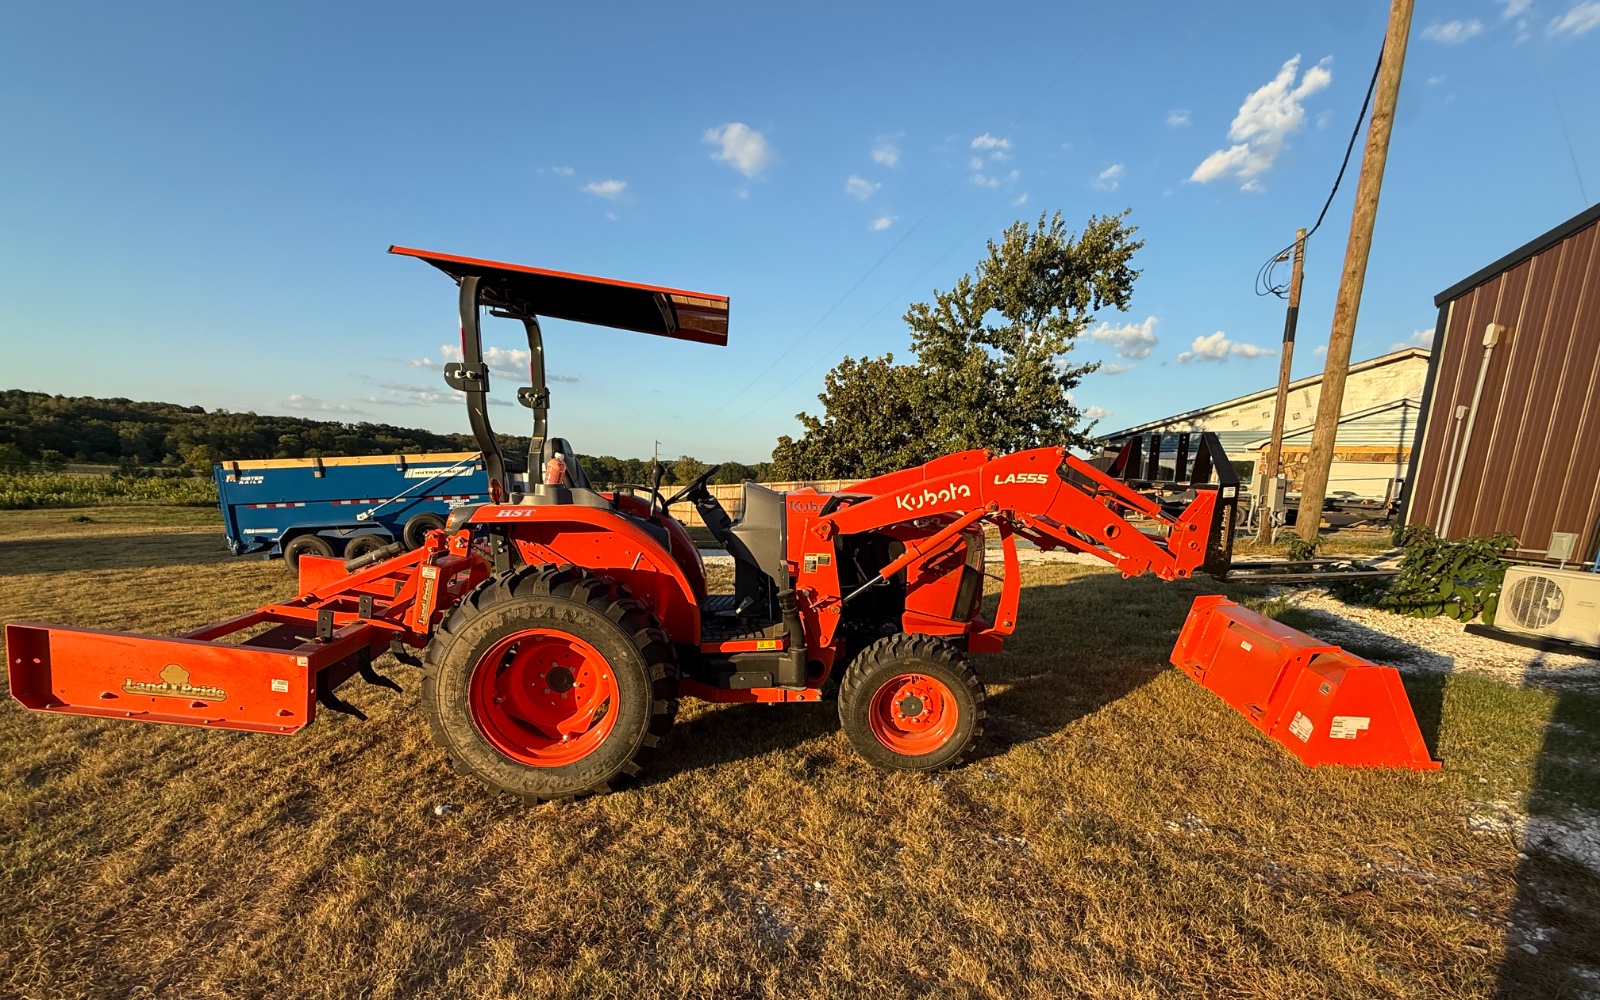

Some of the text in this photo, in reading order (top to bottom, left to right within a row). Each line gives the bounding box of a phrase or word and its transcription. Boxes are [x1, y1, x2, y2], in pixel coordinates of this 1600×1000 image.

[993, 473, 1049, 485] LA555
[895, 482, 971, 511] Kubota
[495, 509, 536, 518] HST
[422, 579, 432, 601] Pride
[418, 603, 428, 624] Land
[497, 604, 582, 624] TITAN
[125, 677, 225, 698] Land Pride
